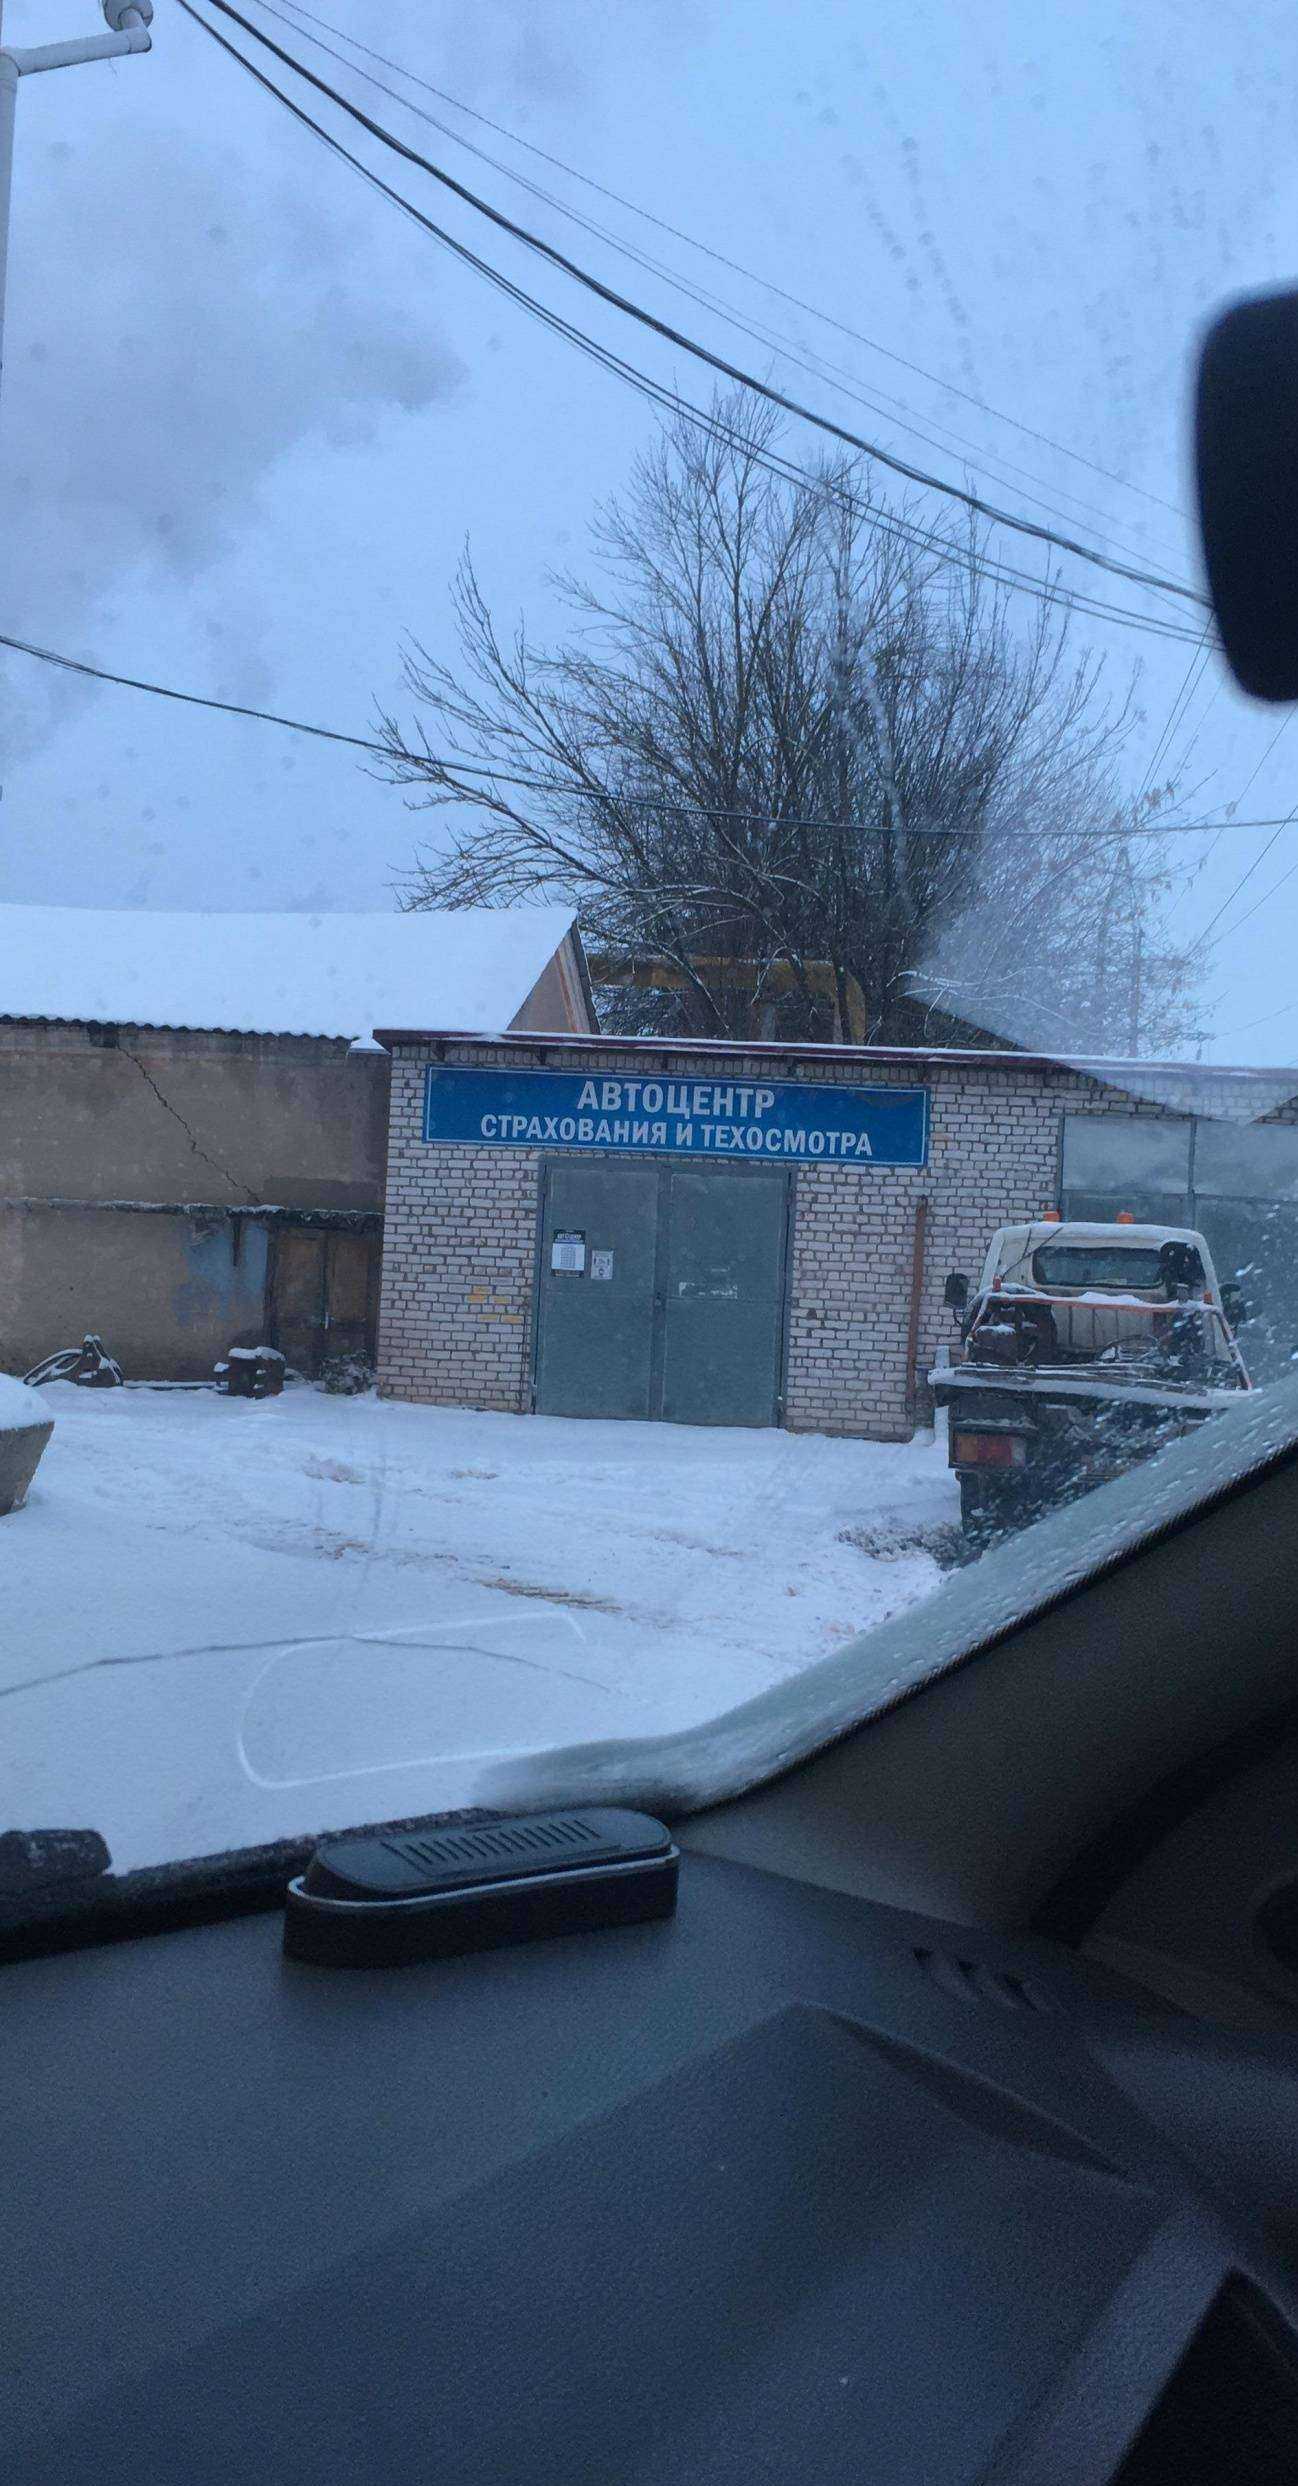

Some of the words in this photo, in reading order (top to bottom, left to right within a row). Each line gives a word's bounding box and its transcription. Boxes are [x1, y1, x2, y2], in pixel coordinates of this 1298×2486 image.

[577, 1081, 775, 1118] АВТОЦЕНТР
[481, 1114, 667, 1145] СТРАХОВАНИЯ
[676, 1124, 694, 1146] И
[701, 1124, 873, 1156] ТЕХОСМОТРА
